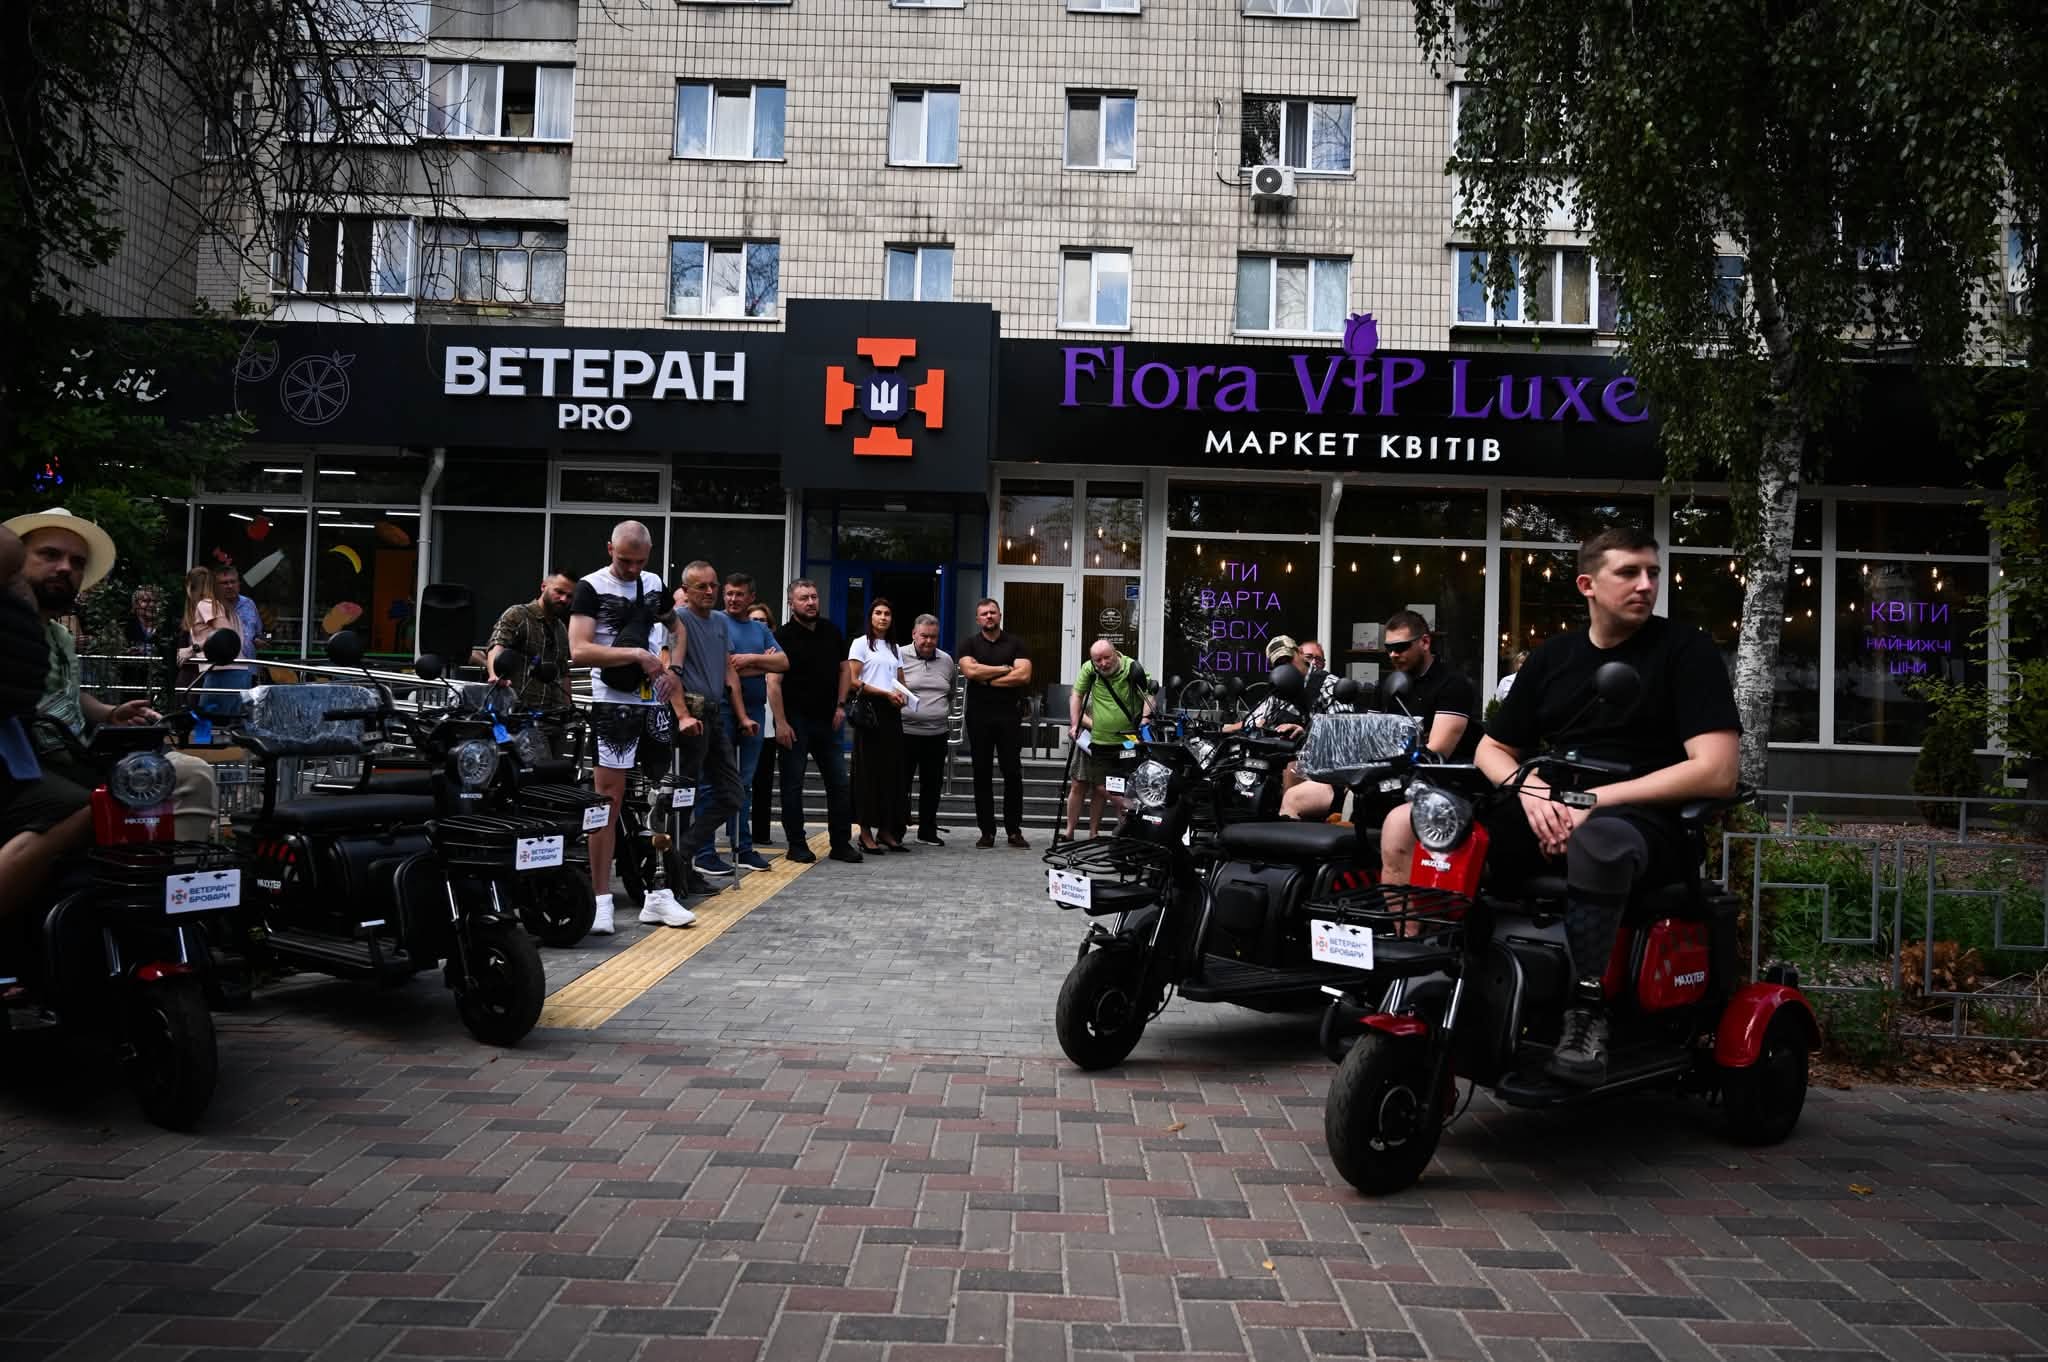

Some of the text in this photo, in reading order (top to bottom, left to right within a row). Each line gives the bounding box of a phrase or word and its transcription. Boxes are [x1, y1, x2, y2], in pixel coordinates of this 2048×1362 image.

[444, 346, 747, 401] ВЕТЕРАН
[1059, 344, 1261, 414] Flora
[1447, 356, 1649, 424] Luxe
[558, 403, 632, 431] PRO
[1204, 429, 1502, 463] МАРКЕТ КВІТІВ
[1226, 561, 1258, 583] ТИ
[1200, 589, 1282, 611] ВАРТА
[1871, 601, 1949, 624] КВІТИ
[1211, 620, 1269, 640] ВСІХ
[1866, 634, 1952, 655] НАЙНИЖЧІ
[1889, 660, 1927, 676] ЦІНИ
[189, 892, 231, 904] БРОВАРИ
[1673, 970, 1705, 988] MAXXTER
